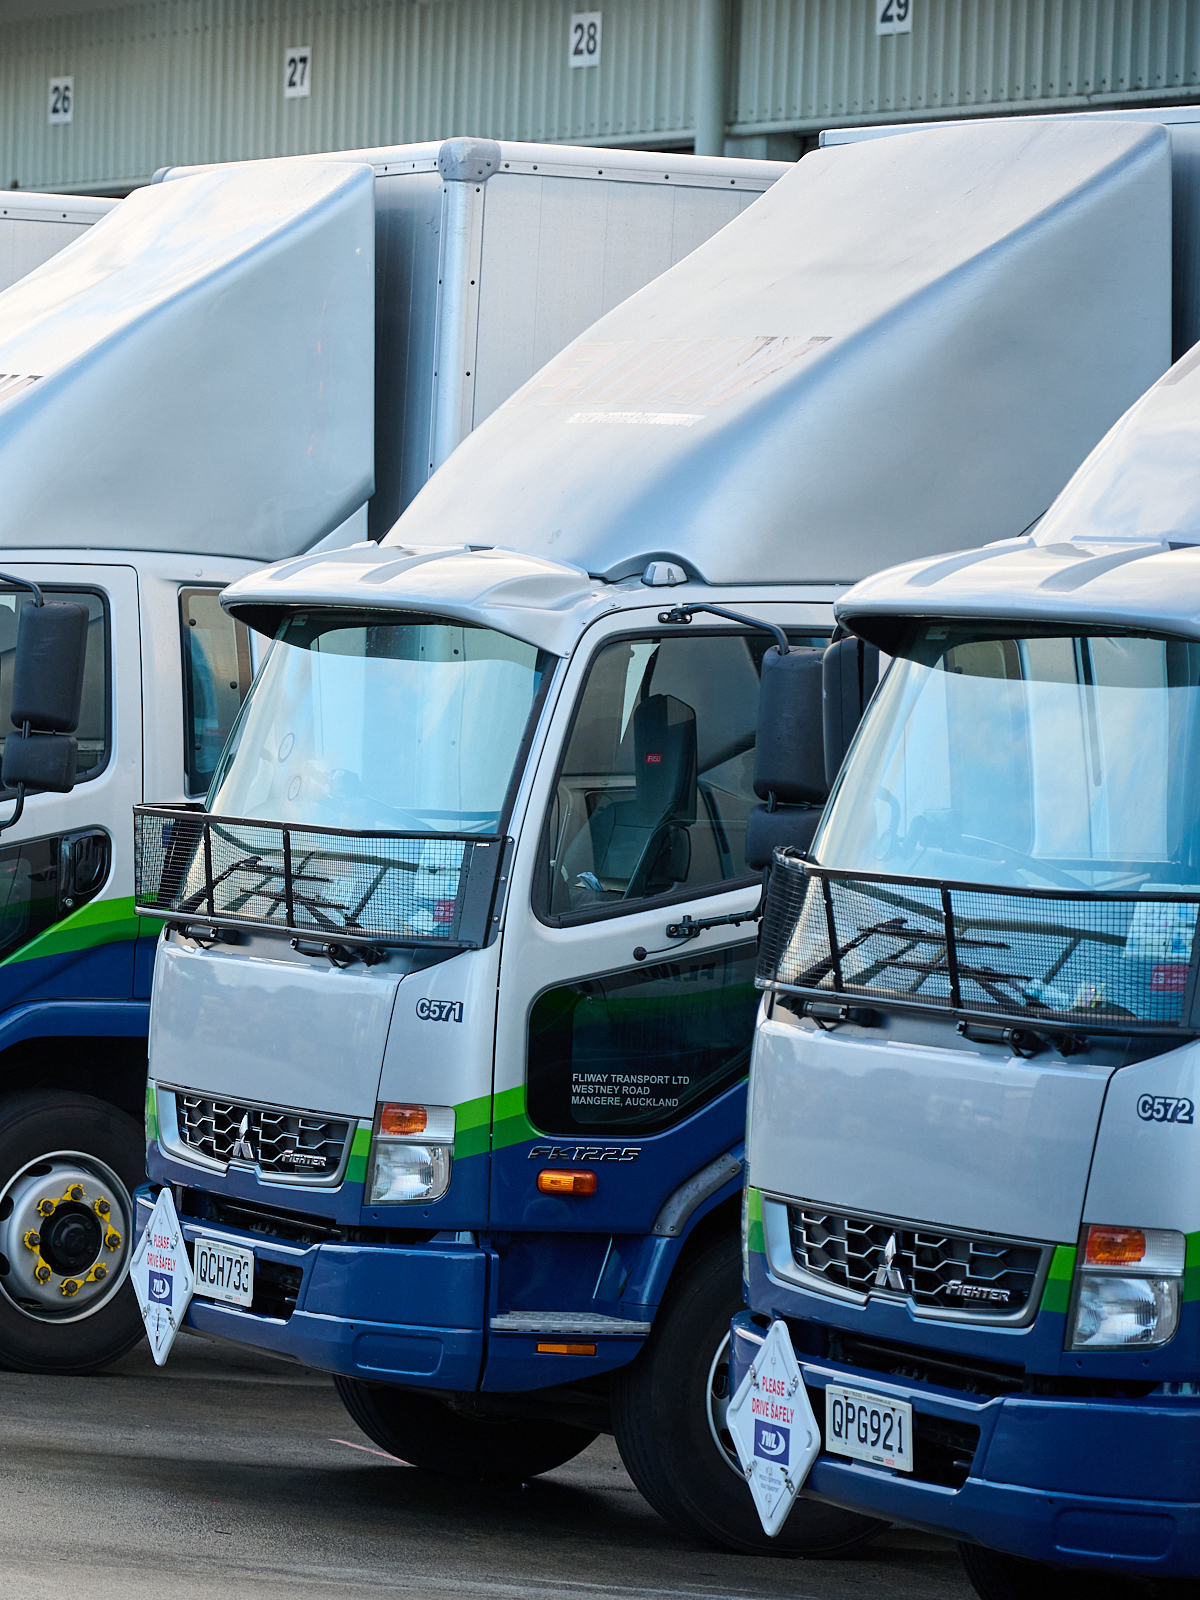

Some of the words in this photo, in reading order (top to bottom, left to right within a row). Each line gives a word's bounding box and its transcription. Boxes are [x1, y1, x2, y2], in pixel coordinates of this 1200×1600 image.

[880, 0, 909, 24] 29
[573, 23, 597, 56] 28
[288, 56, 308, 87] 27
[52, 86, 70, 114] 26
[416, 998, 464, 1023] C571
[571, 1084, 620, 1094] WESTNEY
[622, 1086, 650, 1095] ROAD
[572, 1073, 609, 1082] FLIWAY
[610, 1074, 670, 1084] TRANSPORT
[672, 1076, 690, 1085] LTD
[571, 1096, 623, 1107] MANGERE,
[625, 1098, 679, 1107] AUCKLAND
[1137, 1093, 1194, 1124] C572
[527, 1145, 642, 1161] FK1225
[153, 1234, 170, 1249] PLEASE
[146, 1252, 159, 1268] DRIVE
[159, 1255, 177, 1272] SAFELY
[200, 1251, 248, 1292] QCH733
[945, 1279, 1011, 1301] FIGHTER
[762, 1375, 785, 1397] PLEASE
[751, 1397, 769, 1418] DRIVE
[770, 1402, 795, 1425] SAFELY
[833, 1399, 903, 1454] QPG921
[761, 1430, 777, 1449] TWL
